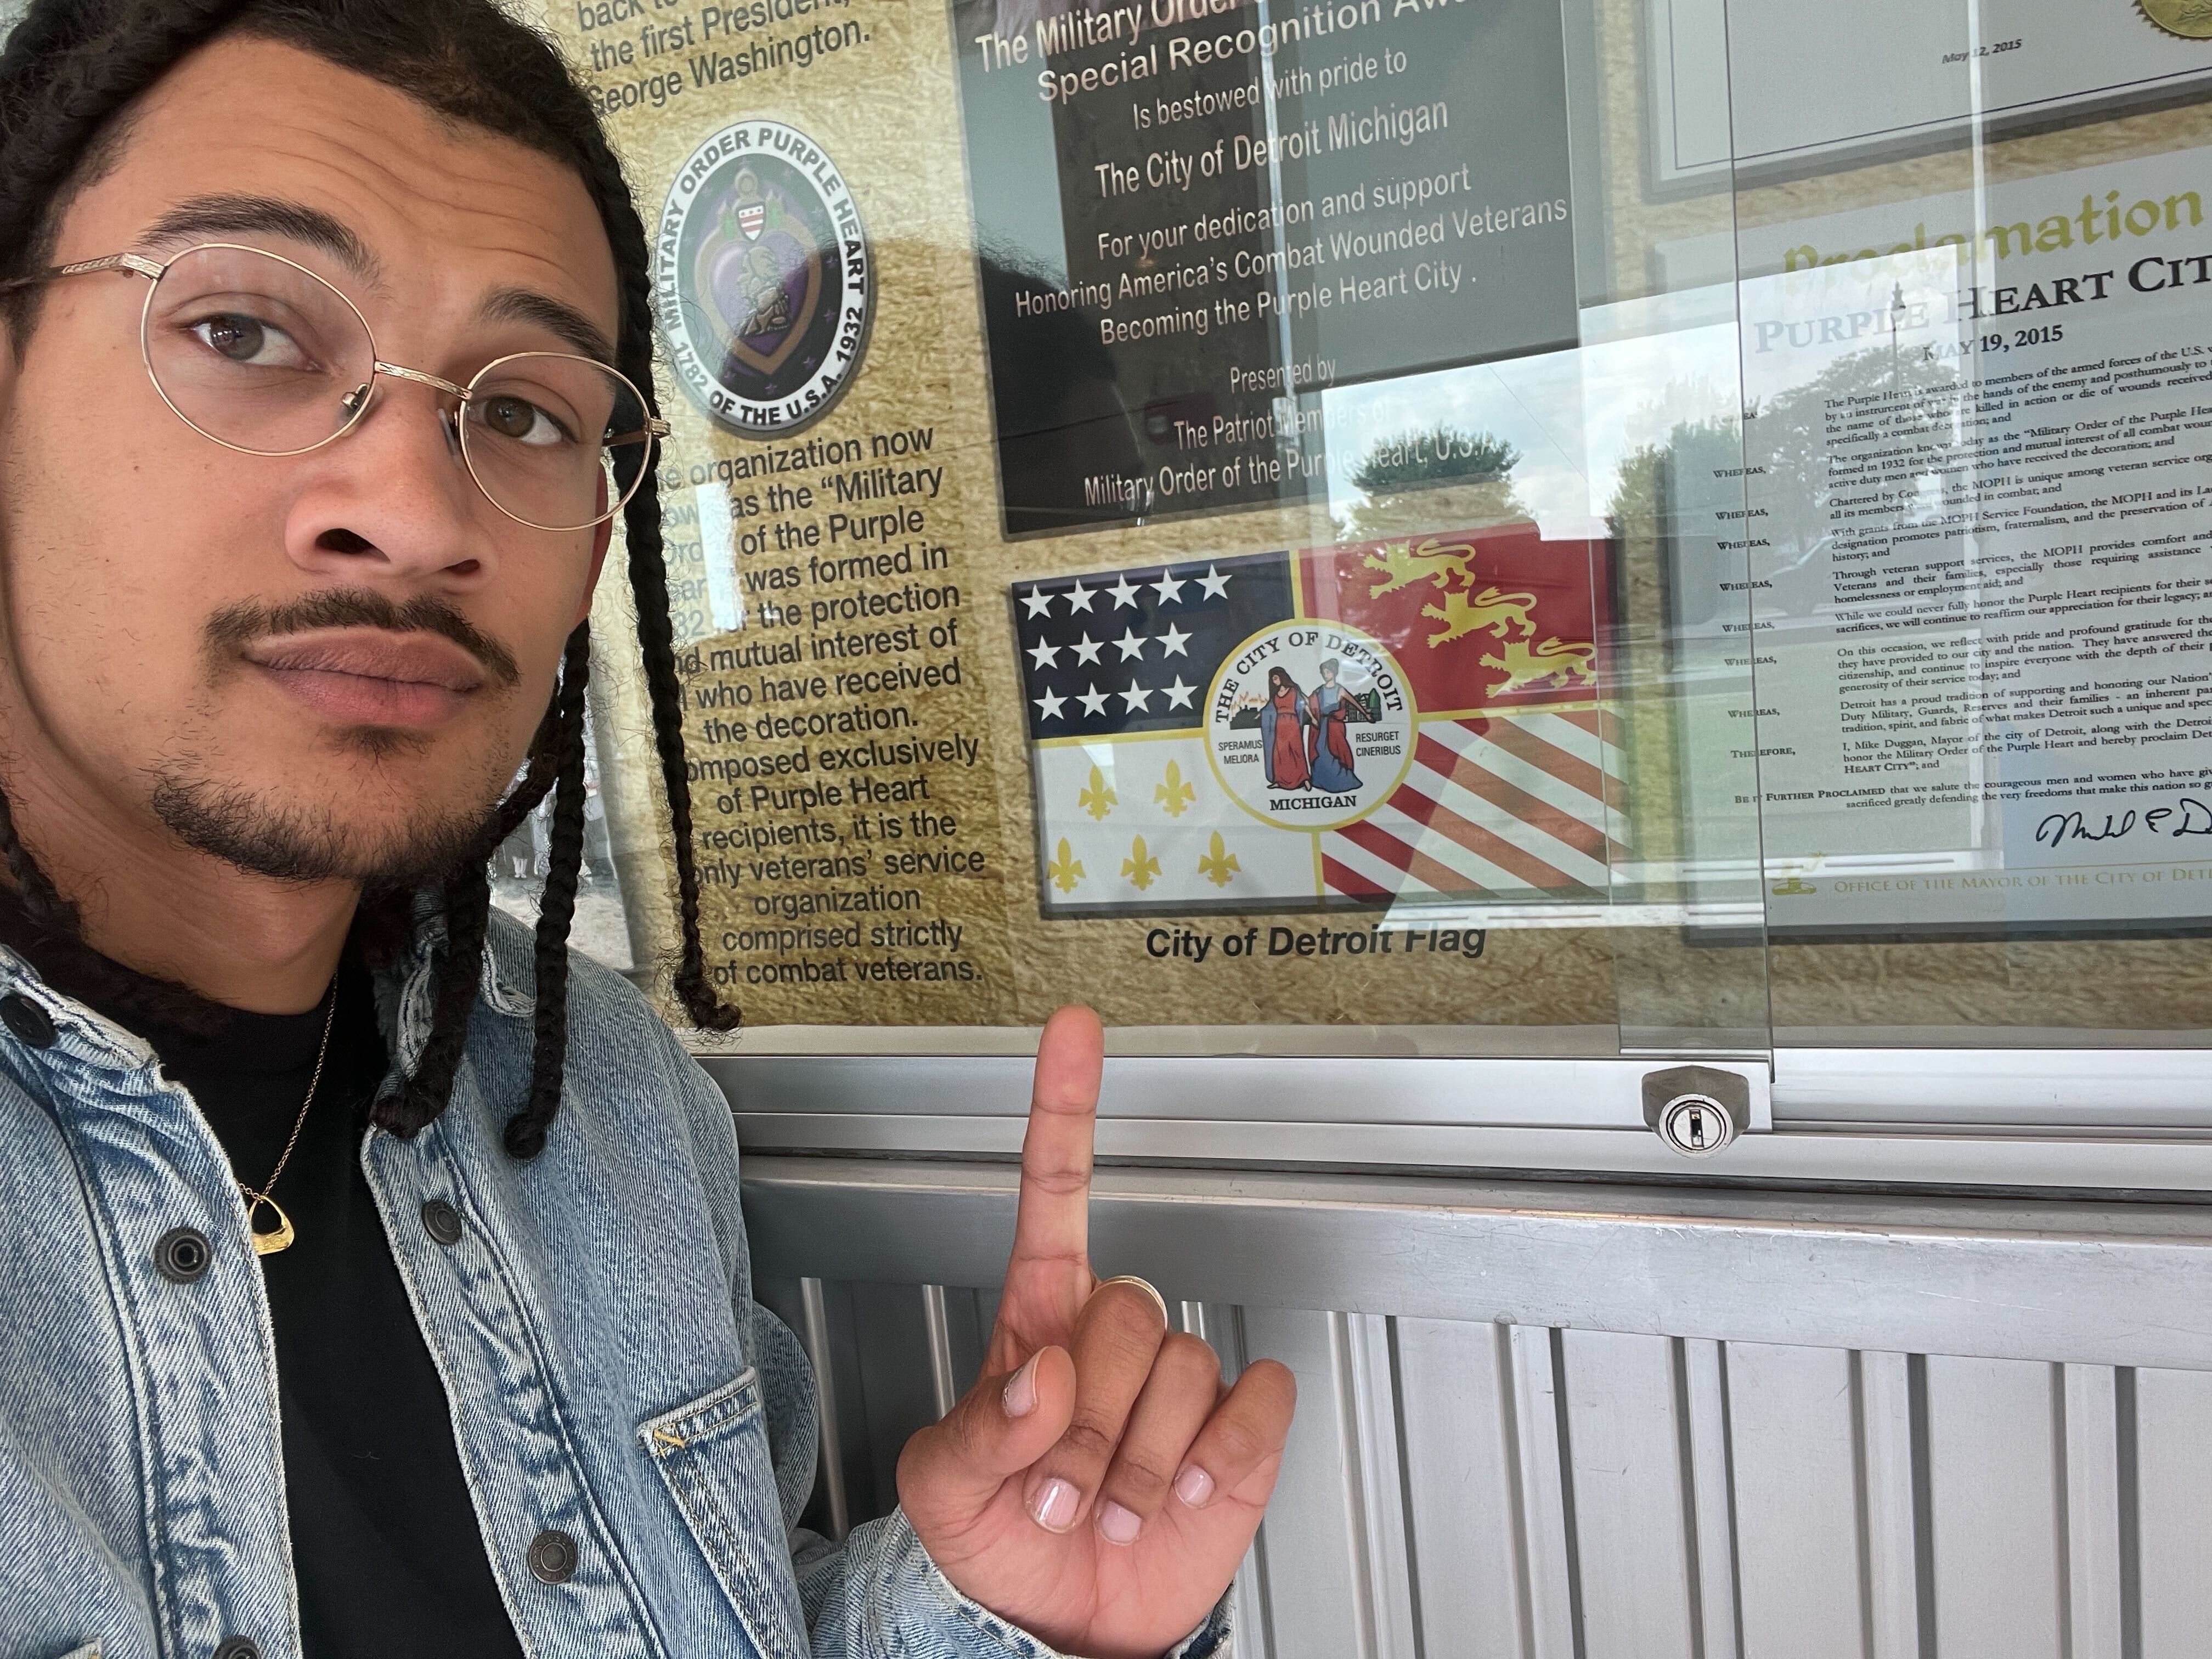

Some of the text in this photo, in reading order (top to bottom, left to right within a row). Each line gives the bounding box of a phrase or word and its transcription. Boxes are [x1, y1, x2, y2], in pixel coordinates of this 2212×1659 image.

[591, 38, 634, 72] the
[640, 15, 695, 57] first
[975, 35, 1028, 72] The
[1036, 4, 1143, 58] Military
[1039, 0, 1381, 103] Special Recognition
[1942, 52, 1970, 64] May
[1992, 39, 2022, 54] 2015
[587, 21, 870, 112] George Washington.
[1133, 48, 1407, 129] Is bestowed with pride to
[1095, 100, 1448, 199] The City of Detroit Michigan
[660, 128, 865, 331] MILITARY ORDER PURPLE HEART
[1098, 163, 1472, 261] For your dedication and support
[1016, 281, 1112, 317] Honoring
[1234, 239, 1324, 279] Combat
[1330, 216, 1444, 259] Wounded
[1452, 196, 1567, 239] Veterans
[1101, 306, 1208, 345] Becoming
[1215, 299, 1250, 329] the
[1257, 281, 1332, 320] Purple
[1340, 269, 1407, 305] Heart
[1754, 255, 2212, 354] PURPLE HEART CIT
[1980, 334, 2010, 352] 19,
[2015, 324, 2064, 347] 2015
[675, 307, 863, 426] 1782 OF THE U.S.A. 1932
[1230, 355, 1336, 394] Presented by
[1173, 420, 1208, 450] The
[1213, 413, 1275, 445] Patriot
[690, 437, 861, 488] organization
[872, 428, 934, 458] now
[769, 485, 813, 512] the
[1084, 476, 1154, 506] Military
[1159, 466, 1217, 496] Order
[1222, 459, 1240, 488] of
[1249, 455, 1280, 483] the
[741, 524, 766, 555] of
[775, 518, 821, 550] the
[829, 505, 924, 544] Purple
[746, 542, 947, 592] was formed in
[1832, 548, 1890, 562] history; and
[758, 601, 802, 629] the
[812, 584, 960, 629] protection
[1835, 592, 1900, 604] homelessness
[1918, 582, 1981, 597] employment
[1983, 579, 2002, 589] aid;
[2005, 576, 2023, 586] and
[2028, 578, 2201, 603] Purple Heart recipients for their
[710, 636, 802, 672] mutual
[811, 624, 919, 661] interest
[932, 618, 957, 648] of
[696, 680, 752, 708] who
[760, 676, 826, 703] have
[836, 657, 961, 695] received
[1215, 631, 1403, 723] THE CITY OF DETROIT
[1839, 669, 2021, 694] generosity of their service today; and
[704, 703, 918, 744] the decoration.
[1356, 731, 1399, 742] RESURGET
[688, 732, 979, 785] omposed exclusively
[1218, 740, 1262, 751] SPERAMUS
[1224, 754, 1260, 764] MELIORA
[1356, 746, 1401, 757] CINERIBUS
[717, 775, 930, 815] of Purple Heart
[1270, 795, 1356, 811] MICHIGAN
[1765, 787, 1886, 802] FURTHER PROCLAIMED
[702, 811, 957, 853] recipients, it is the
[695, 858, 741, 889] only
[884, 845, 985, 875] service
[1834, 880, 1891, 893] OFFICE
[1896, 879, 1917, 891] OF
[1924, 878, 1955, 890] THE
[1961, 876, 2023, 889] MAYOR
[2027, 875, 2047, 887] OF
[2055, 873, 2087, 886] THE
[2095, 872, 2135, 885] CITY
[2142, 870, 2162, 883] OF
[755, 884, 921, 920] organization
[723, 919, 963, 955] comprised strictly
[1147, 923, 1486, 962] City of Detroit Flag
[714, 957, 983, 985] of combat veterans.
